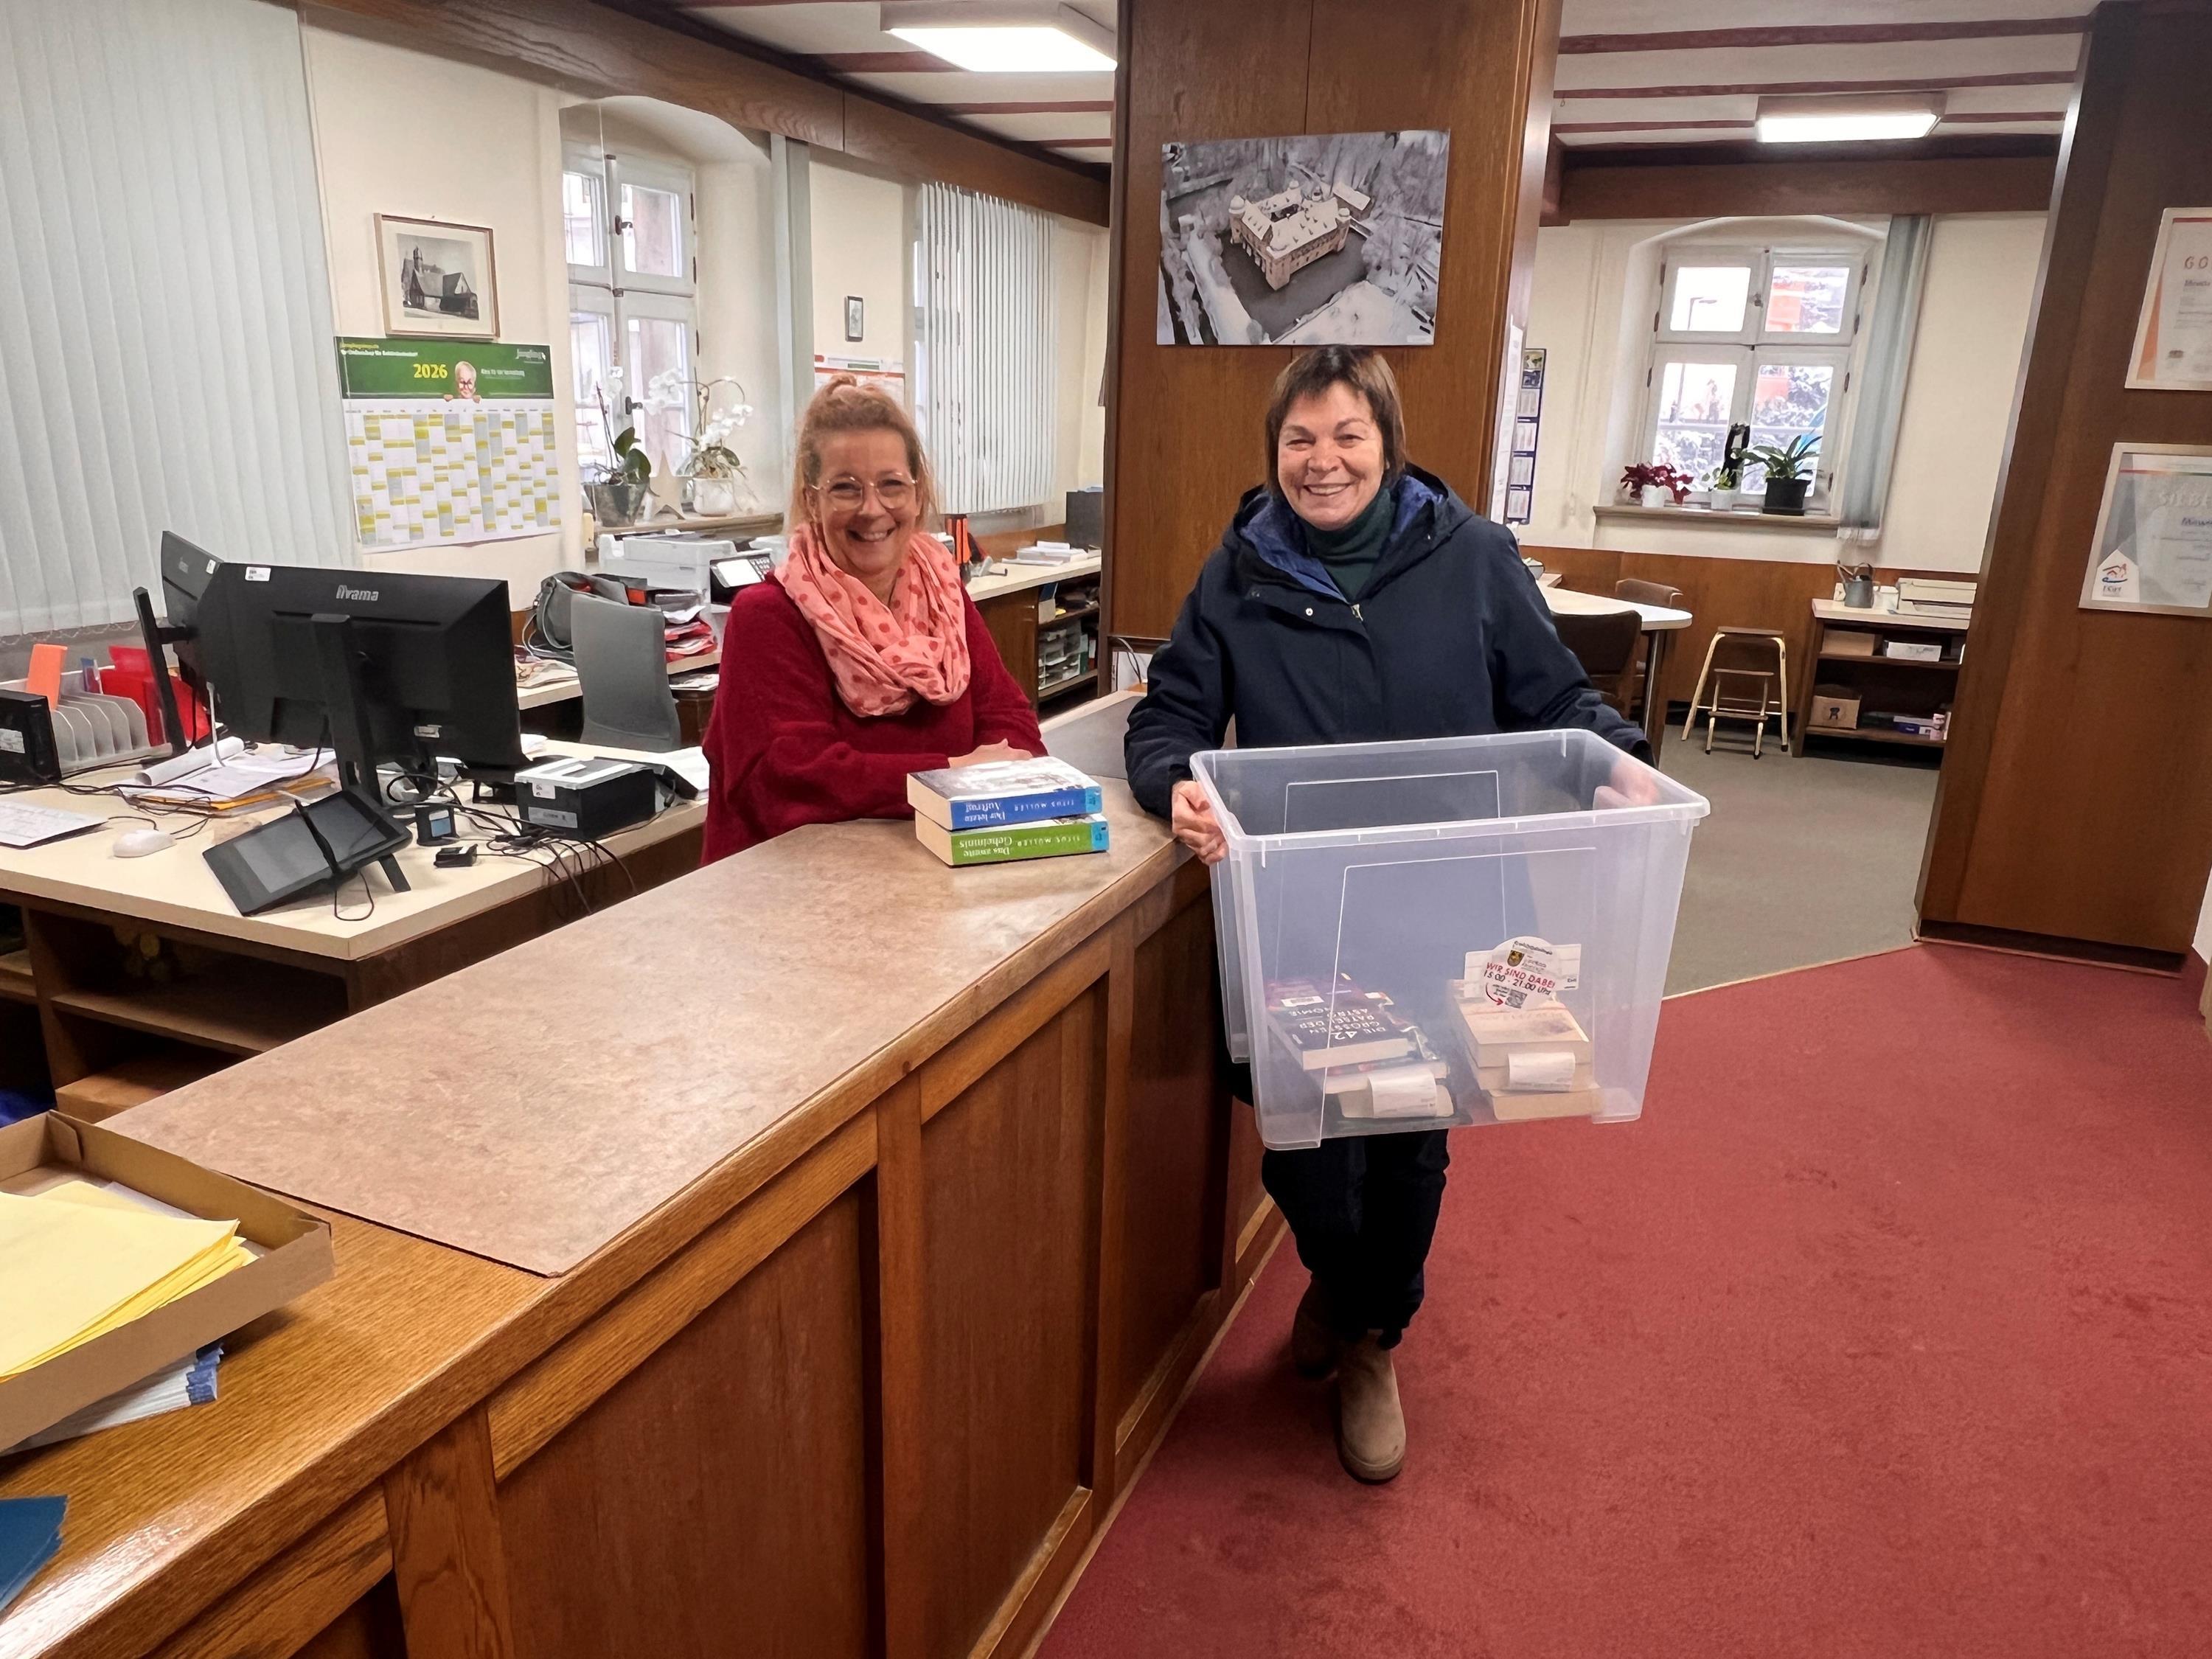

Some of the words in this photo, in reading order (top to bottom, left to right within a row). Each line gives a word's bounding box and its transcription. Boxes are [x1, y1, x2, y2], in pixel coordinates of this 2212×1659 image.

[2184, 255, 2212, 270] GO
[413, 364, 448, 378] 2026
[993, 847, 1010, 856] Das
[1486, 961, 1503, 973] WIR
[1505, 968, 1526, 980] SIND
